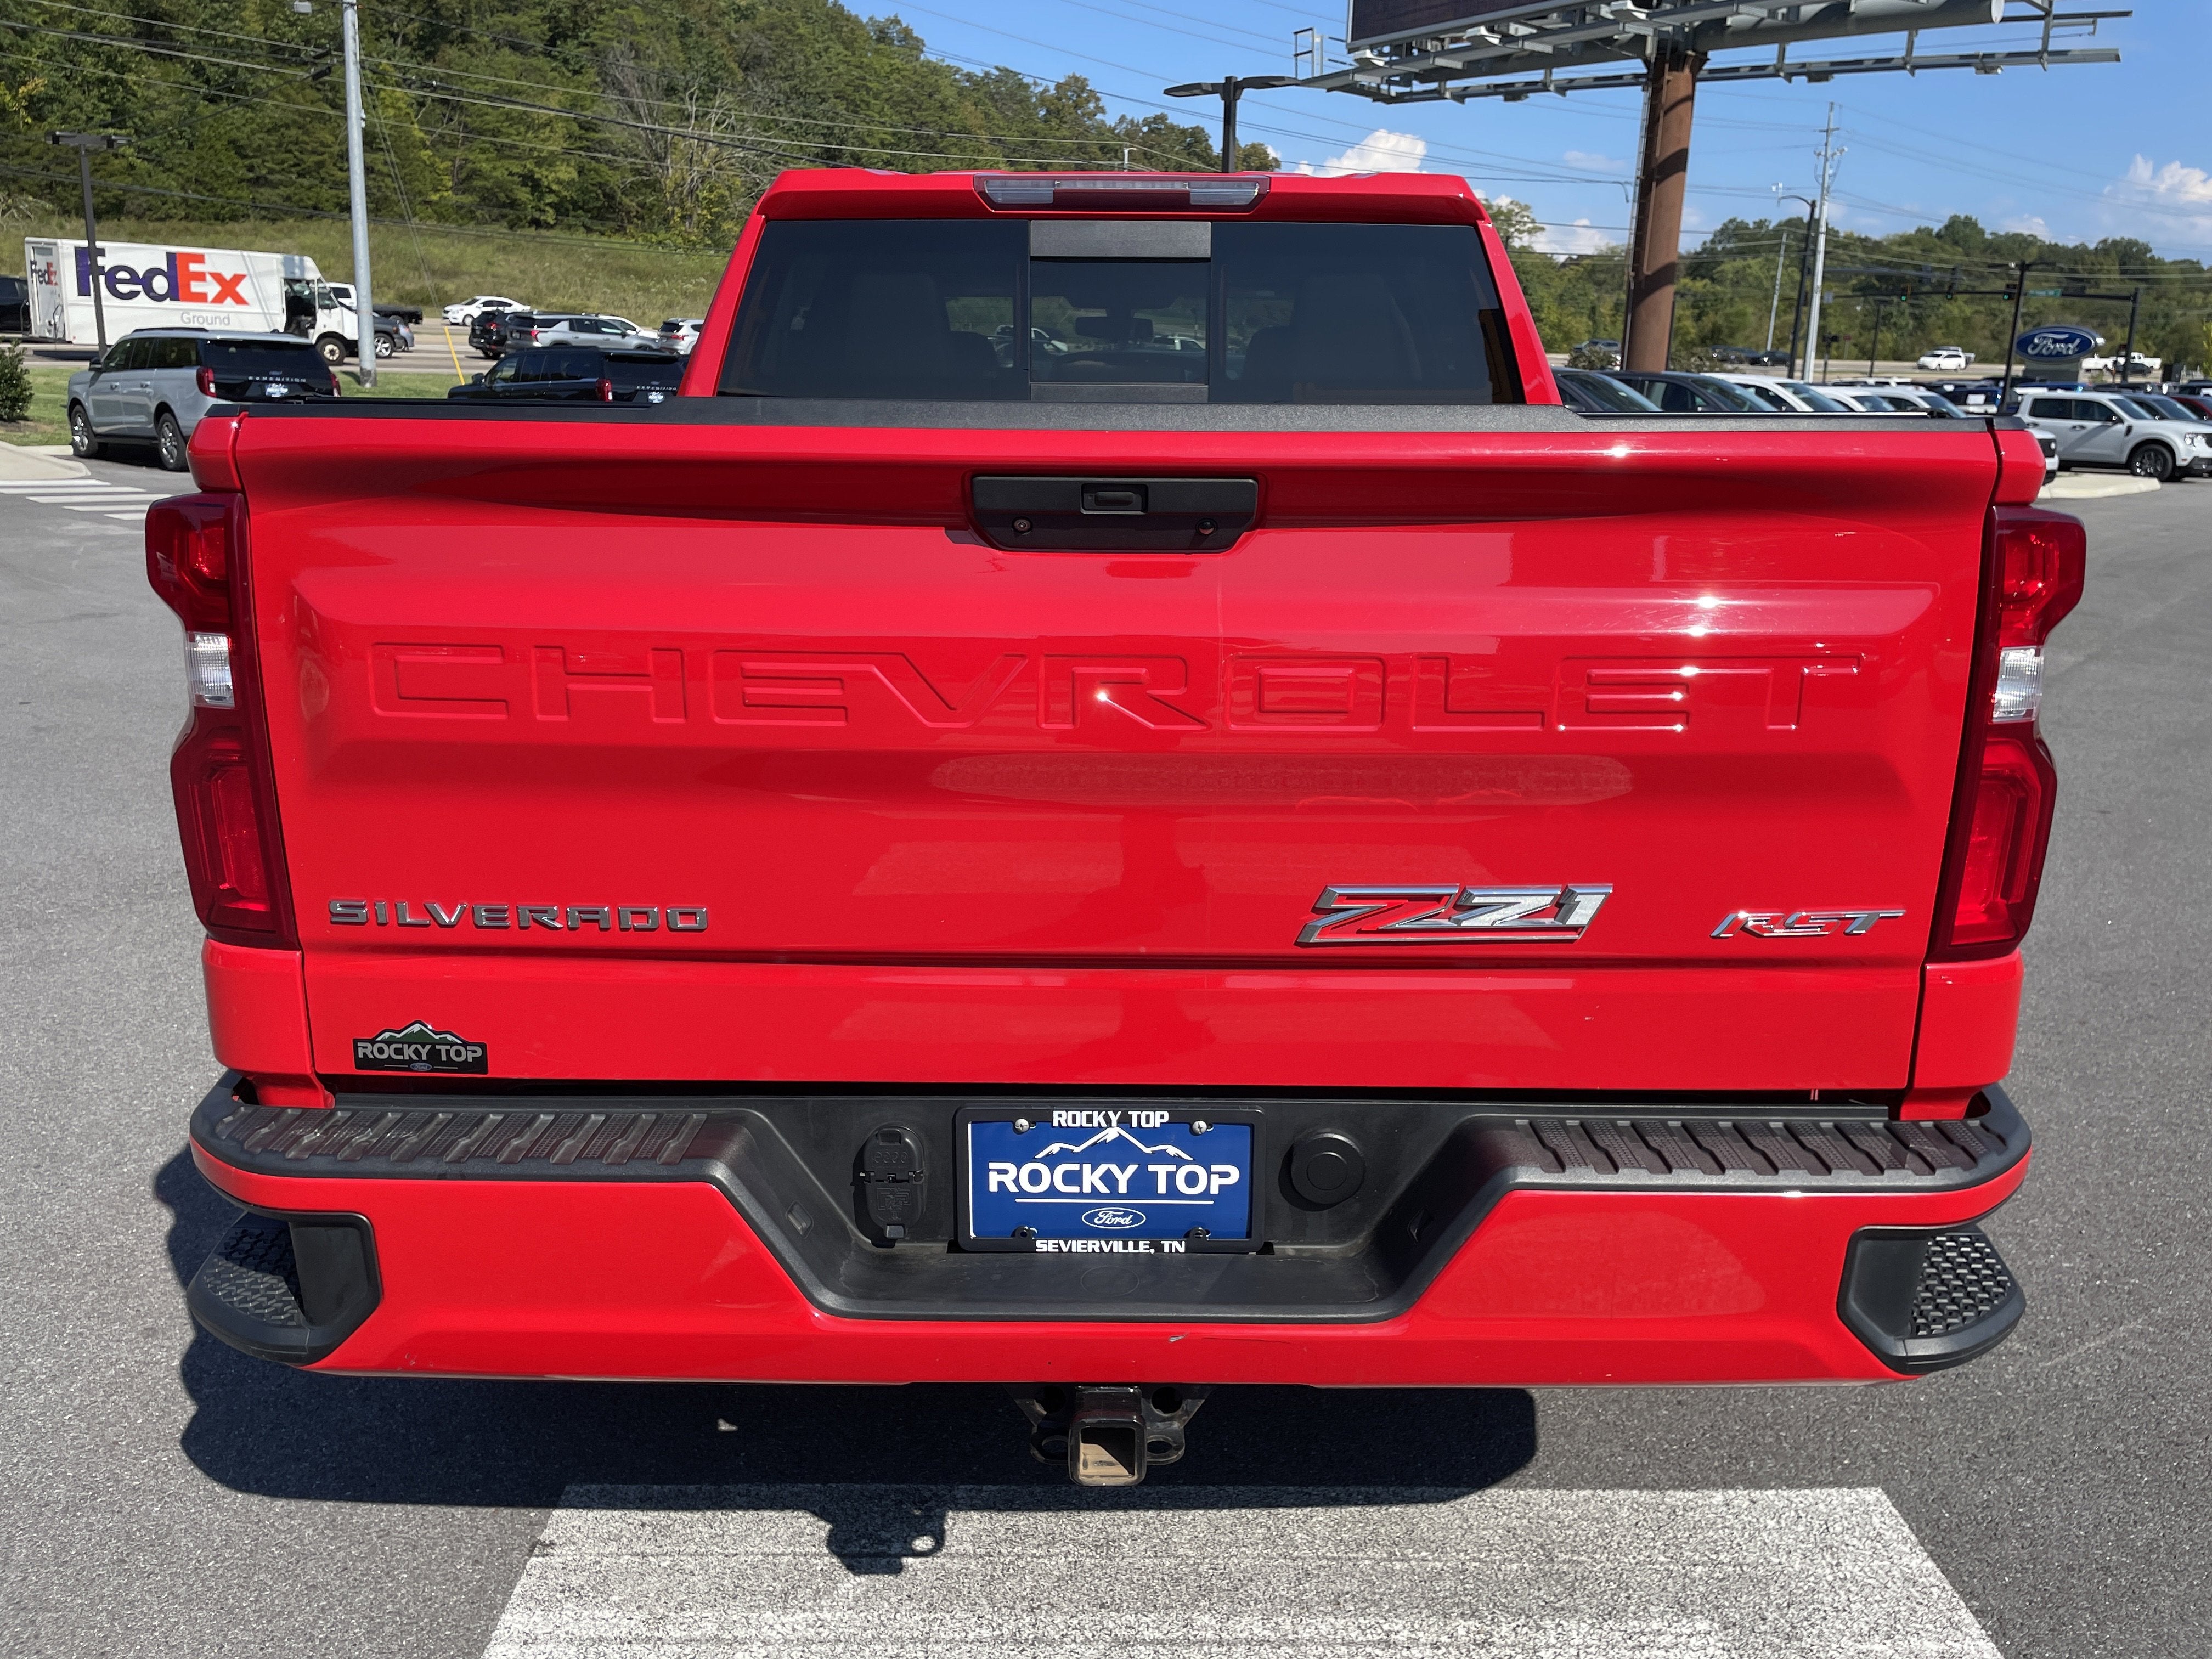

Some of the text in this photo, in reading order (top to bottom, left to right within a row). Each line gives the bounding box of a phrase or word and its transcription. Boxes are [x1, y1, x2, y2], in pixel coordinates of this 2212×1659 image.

[30, 259, 58, 286] FedEx
[74, 246, 250, 306] FedEx
[180, 311, 230, 326] Ground
[2027, 332, 2081, 356] Ford
[370, 642, 1864, 732] CHEVROLET
[328, 900, 709, 932] SILVERADO
[1295, 883, 1613, 946] Z71
[1709, 910, 1907, 939] RST
[357, 1042, 482, 1062] ROCKY TOP
[1053, 1110, 1169, 1128] ROCKY TOP
[988, 1161, 1240, 1195] ROCKY TOP
[1094, 1210, 1133, 1224] Ford
[1035, 1240, 1186, 1254] SEVIERVILLE, TN
